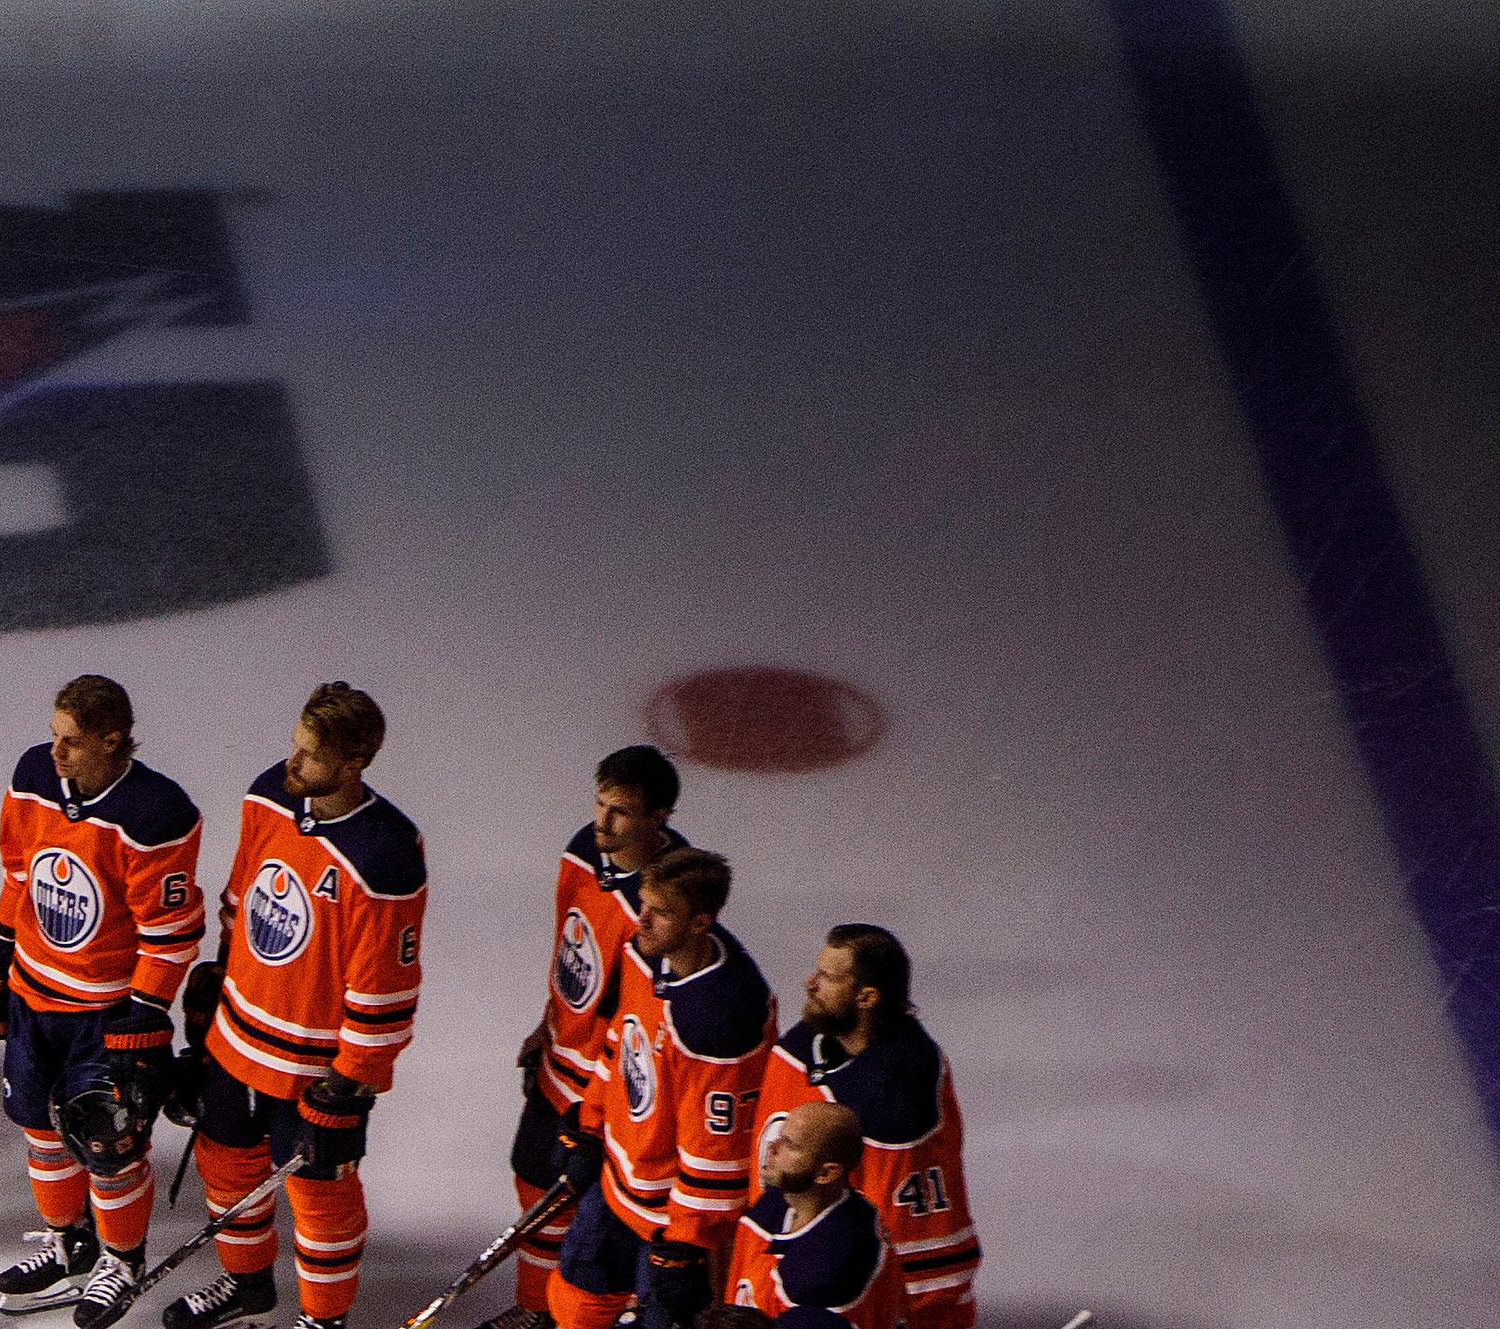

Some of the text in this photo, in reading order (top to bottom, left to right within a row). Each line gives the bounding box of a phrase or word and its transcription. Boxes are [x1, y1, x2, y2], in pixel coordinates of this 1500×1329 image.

[35, 878, 90, 945] OILERS
[311, 874, 342, 902] A
[250, 895, 311, 952] OILERS
[893, 1166, 950, 1217] 41
